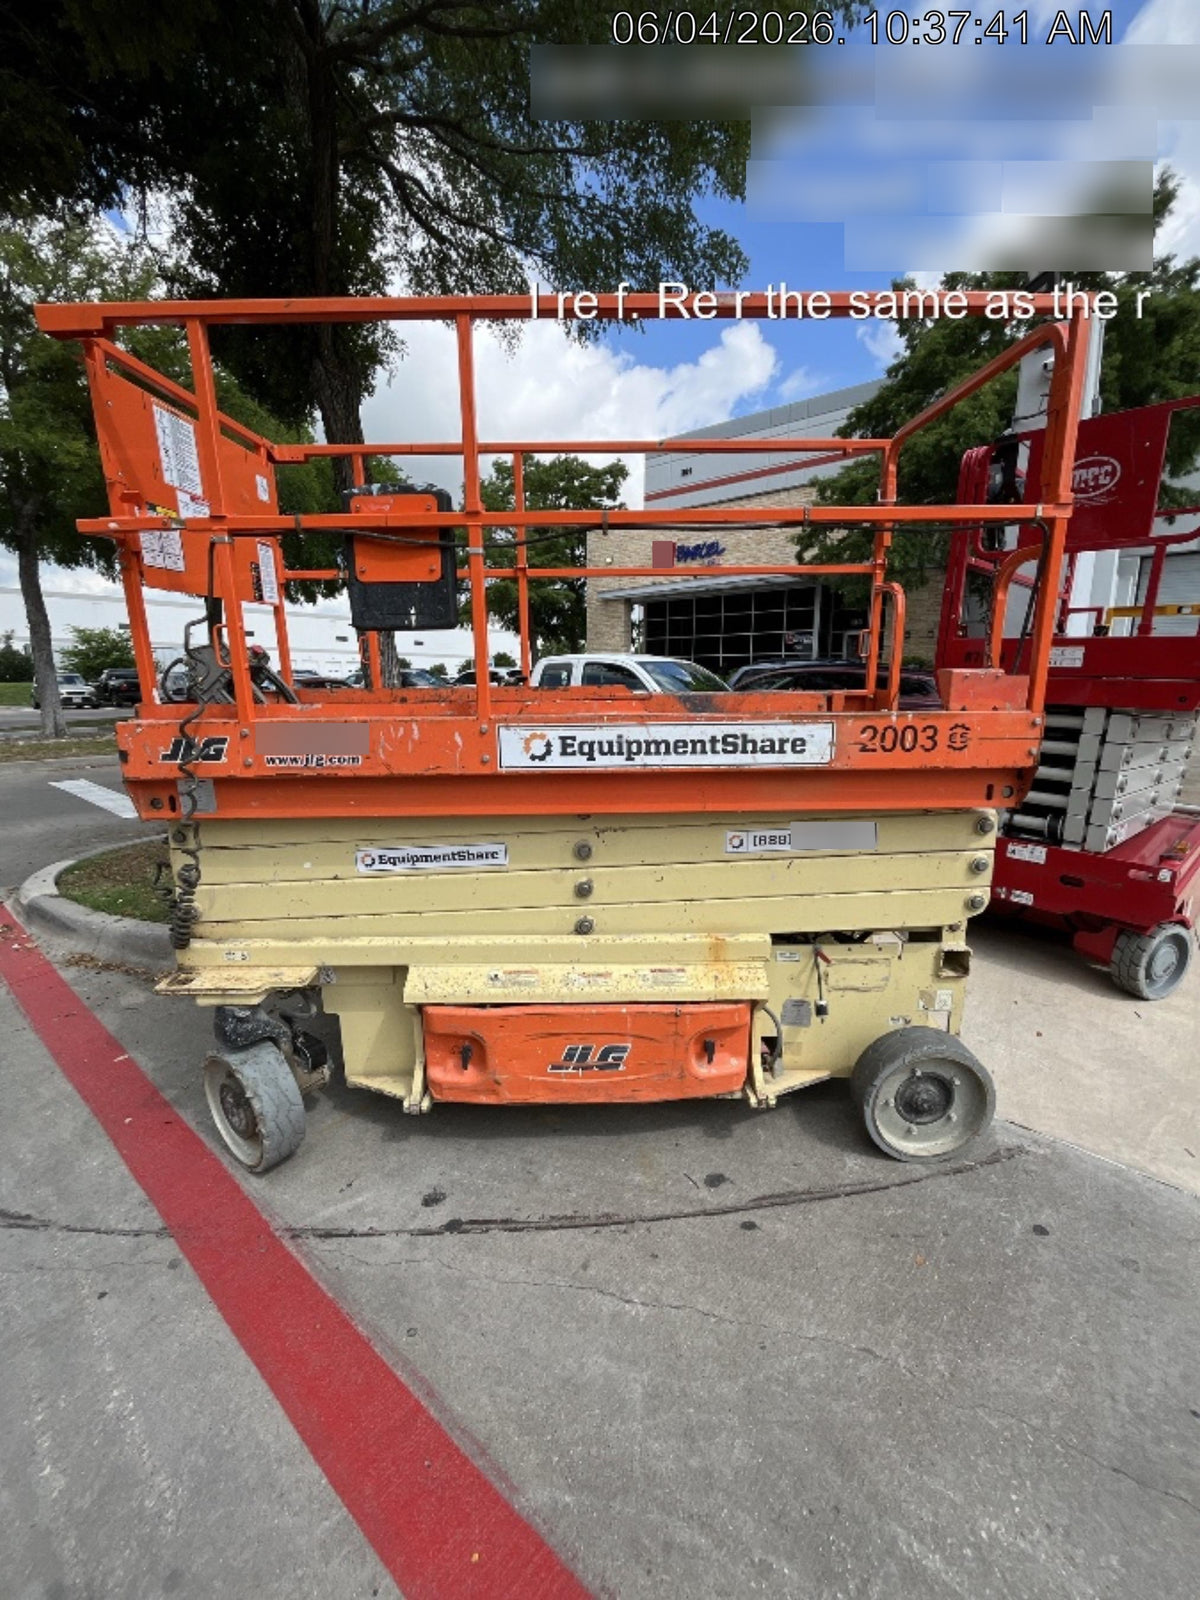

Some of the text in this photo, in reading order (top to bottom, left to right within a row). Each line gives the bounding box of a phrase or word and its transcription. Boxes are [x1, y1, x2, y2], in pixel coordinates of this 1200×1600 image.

[558, 734, 807, 761] EquipmentShare
[858, 725, 938, 752] 2003
[264, 753, 362, 768] www.jlg.com
[378, 850, 499, 866] EquipmentShare
